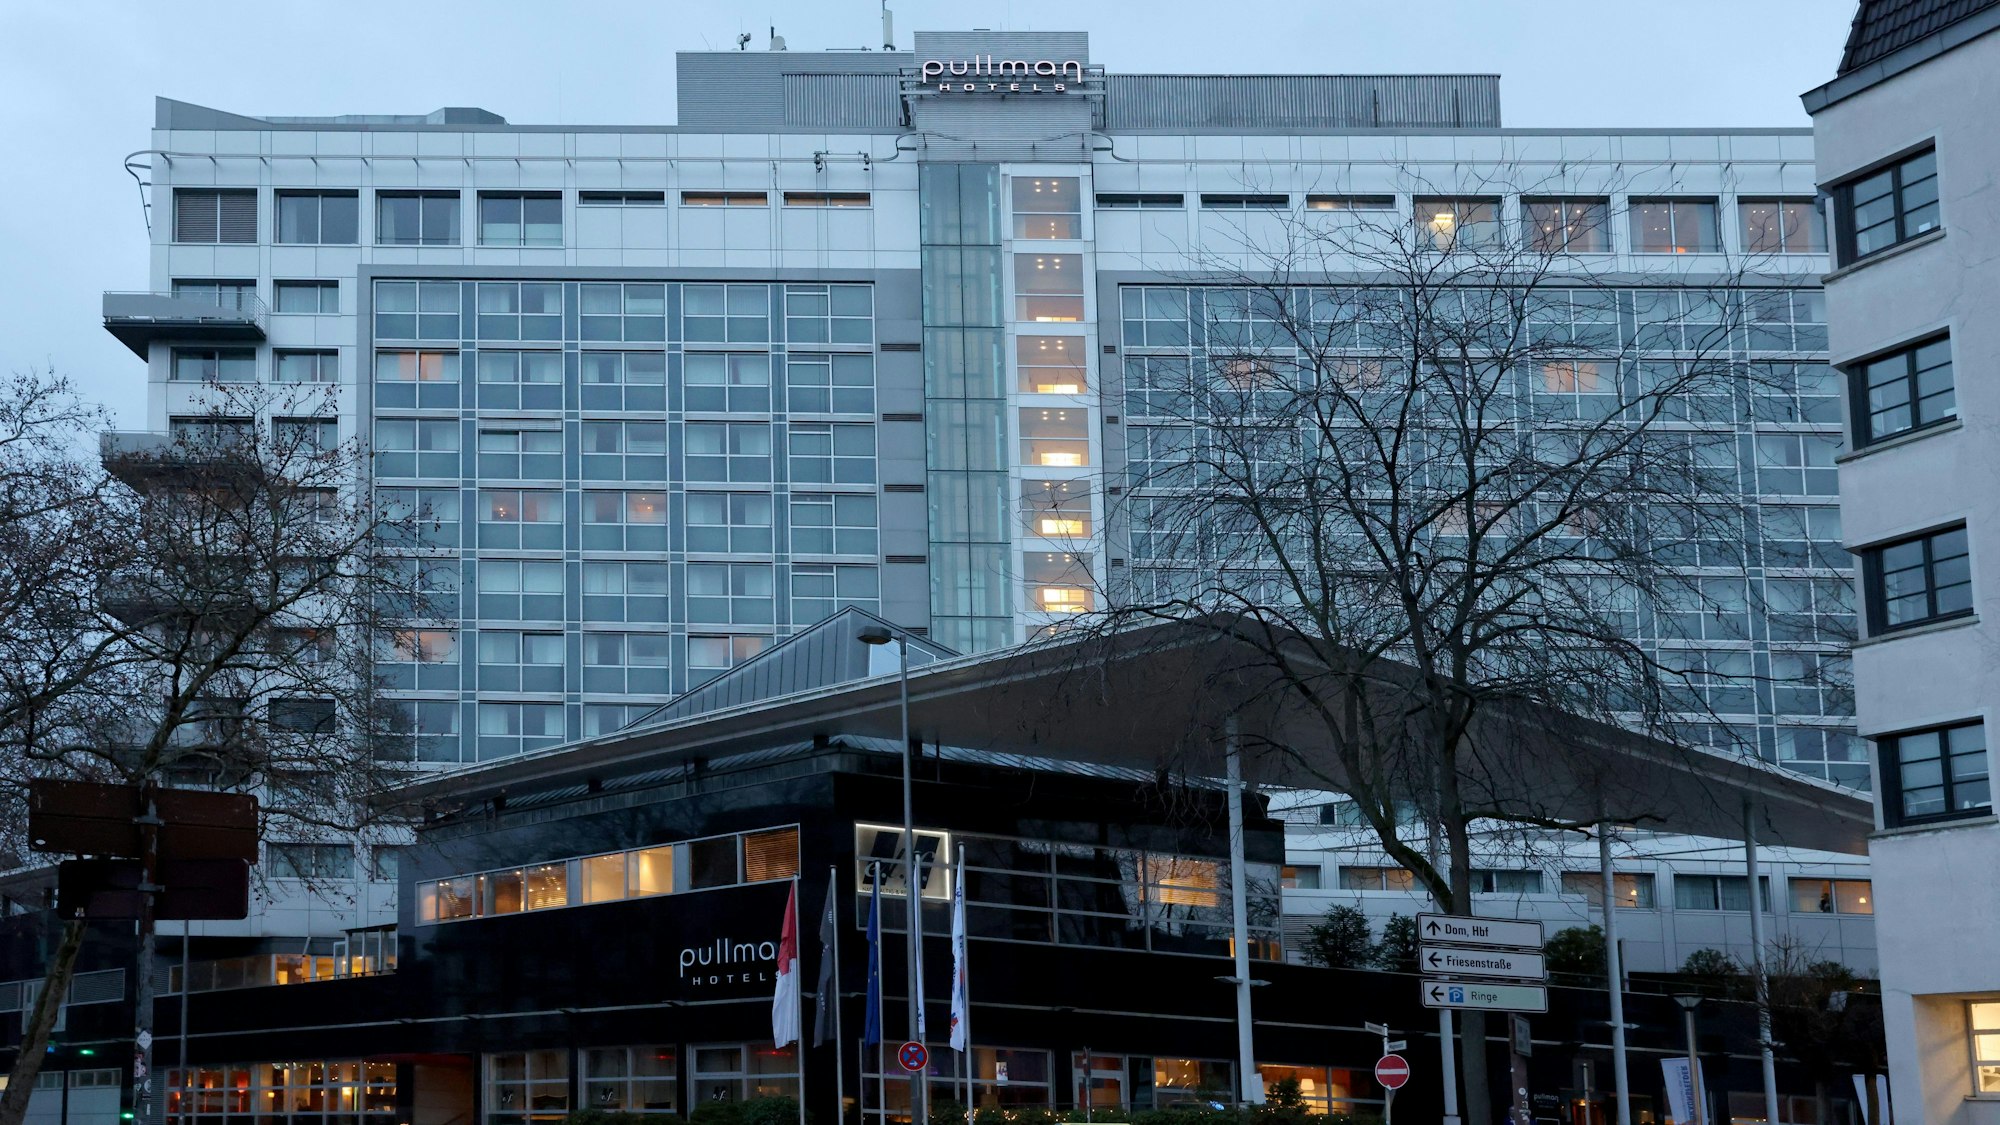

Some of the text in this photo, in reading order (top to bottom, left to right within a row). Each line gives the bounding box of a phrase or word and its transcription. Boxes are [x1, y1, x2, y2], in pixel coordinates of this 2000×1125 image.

[922, 54, 1082, 84] pullman
[939, 83, 1066, 92] HOTELS
[1445, 924, 1489, 938] Dom, Hbf
[680, 938, 776, 978] pullma
[1446, 955, 1512, 970] Friesenstraße
[1471, 991, 1498, 1004] Ringe
